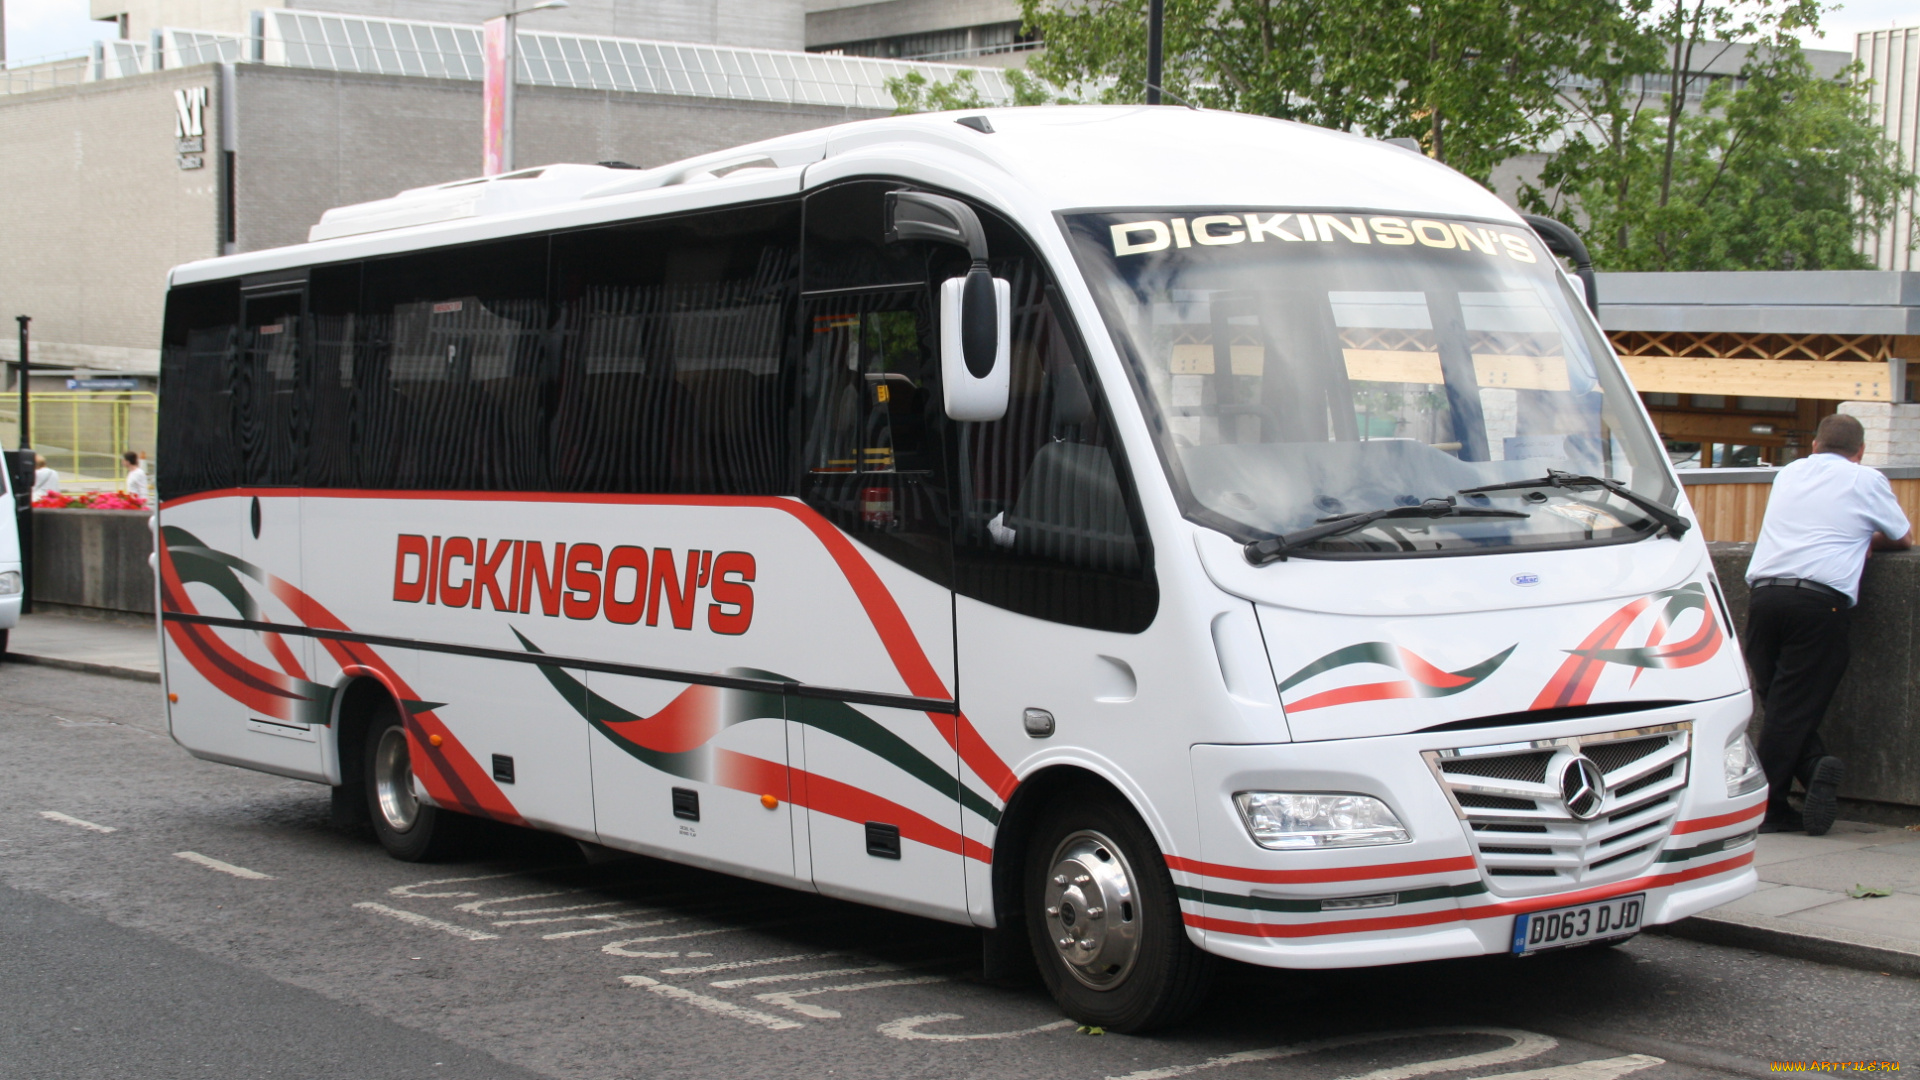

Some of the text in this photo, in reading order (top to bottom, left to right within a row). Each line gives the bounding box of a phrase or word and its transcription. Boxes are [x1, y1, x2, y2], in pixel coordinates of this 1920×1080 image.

[174, 86, 207, 137] NT
[1110, 213, 1538, 263] DICKINSON'S
[393, 533, 757, 636] DICKINSON'S
[1529, 900, 1639, 944] DD63 DJD
